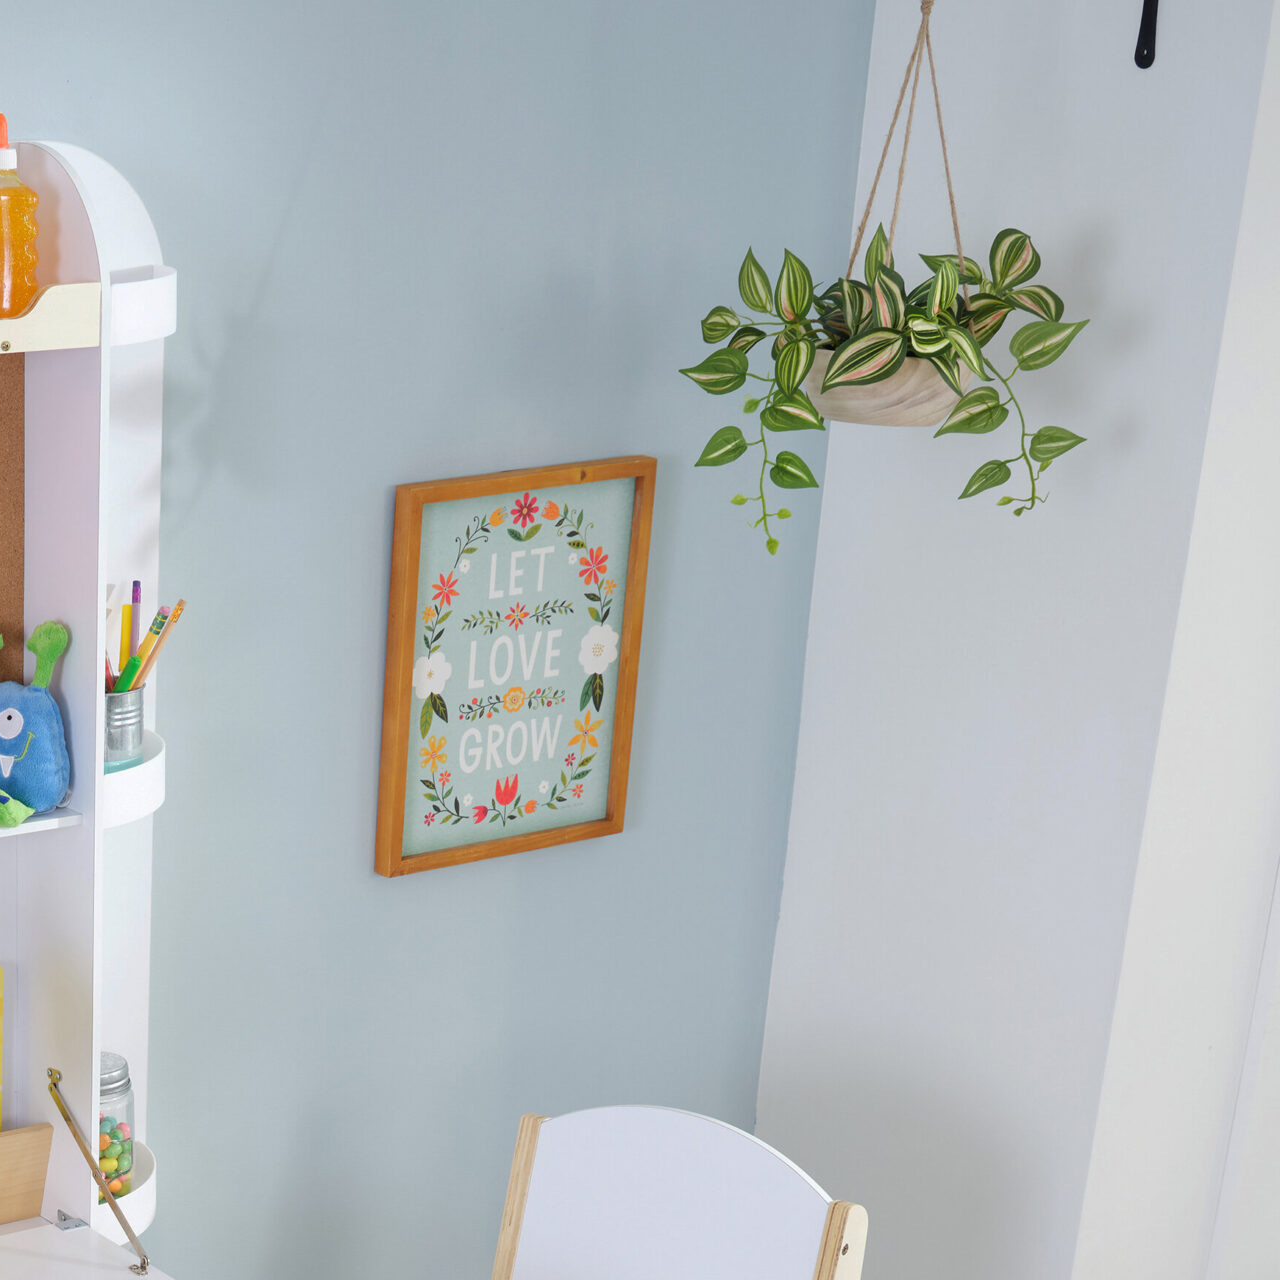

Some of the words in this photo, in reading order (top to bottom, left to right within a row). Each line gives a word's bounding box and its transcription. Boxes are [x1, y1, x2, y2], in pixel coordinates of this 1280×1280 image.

[489, 545, 556, 600] LET
[468, 628, 563, 690] LOVE
[459, 714, 563, 775] GROW
